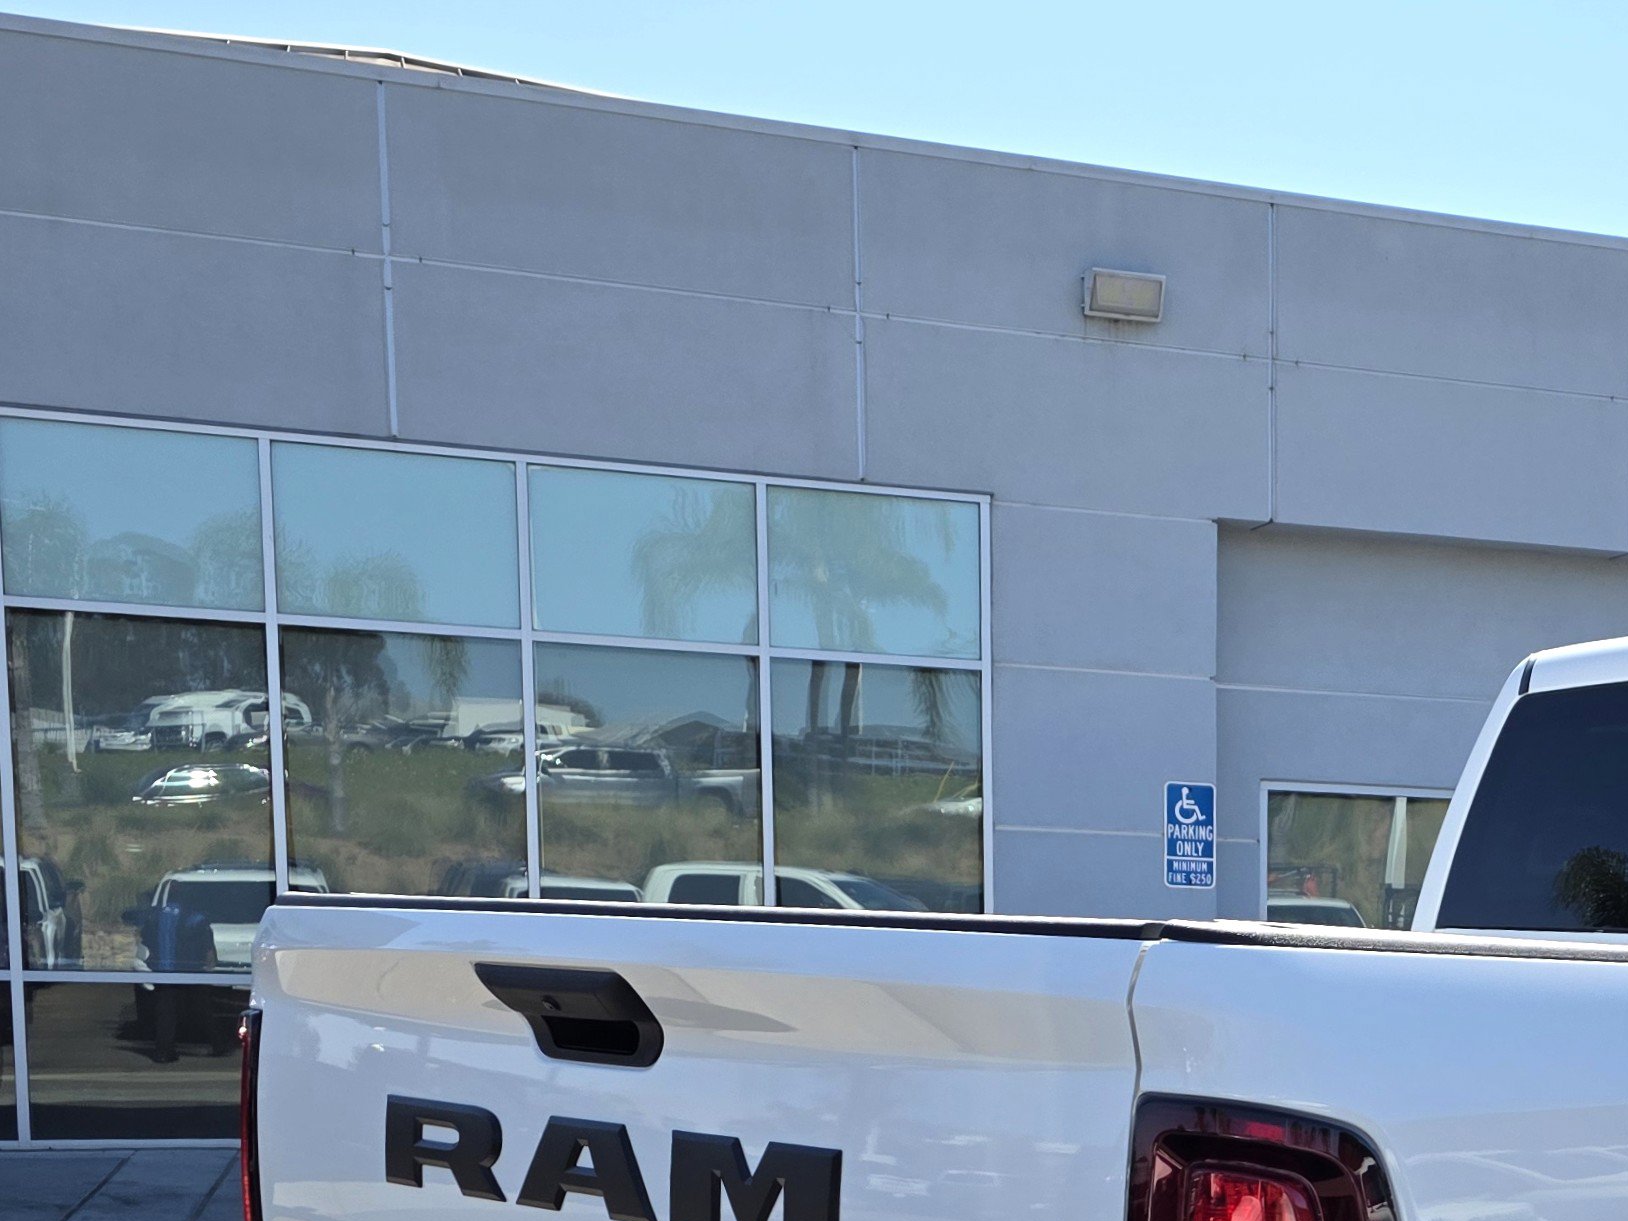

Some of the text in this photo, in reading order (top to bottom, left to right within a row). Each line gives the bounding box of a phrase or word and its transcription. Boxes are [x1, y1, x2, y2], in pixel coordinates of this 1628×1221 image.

[1167, 823, 1213, 841] PARKING
[1176, 840, 1204, 857] ONLY
[1172, 860, 1208, 873] MINIMUM
[1168, 872, 1212, 885] FINE $250
